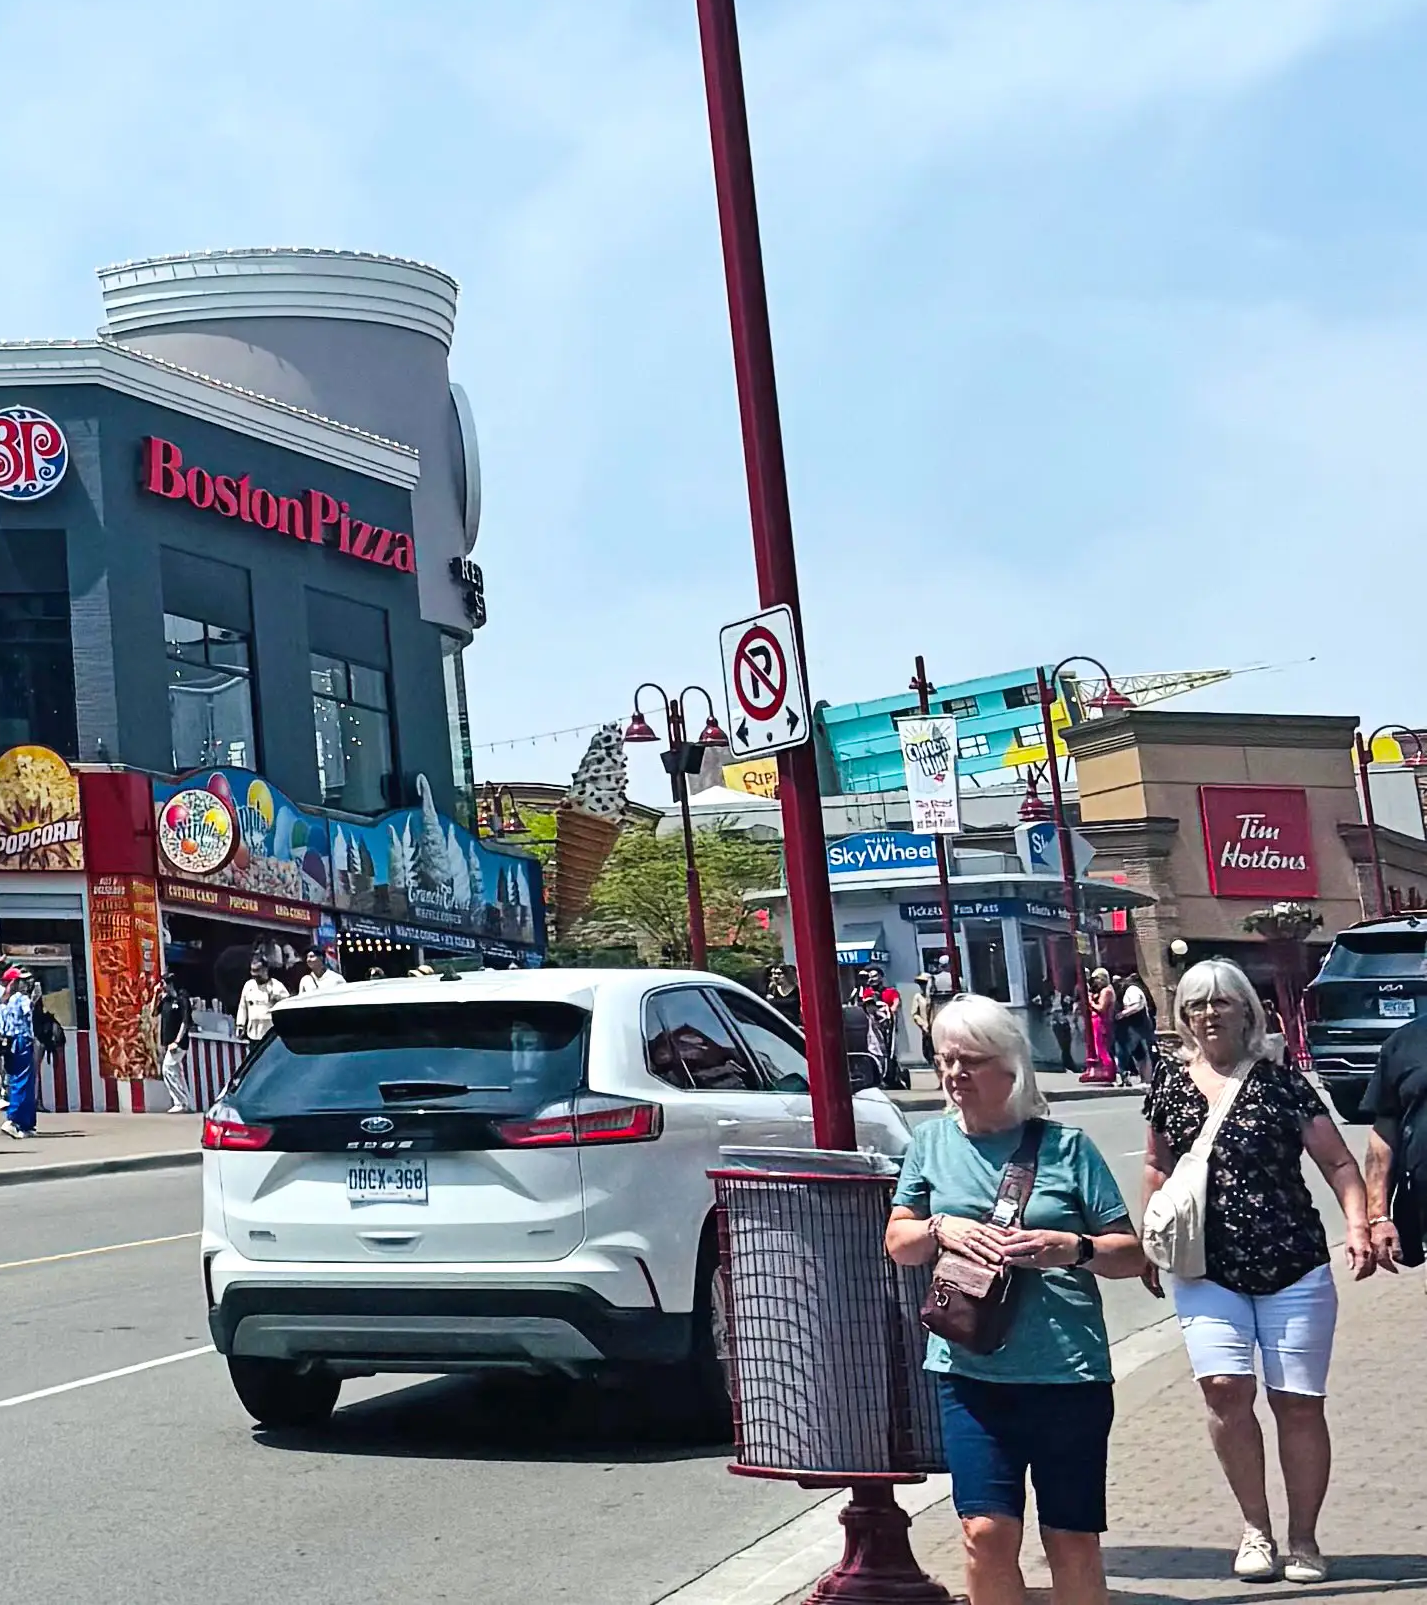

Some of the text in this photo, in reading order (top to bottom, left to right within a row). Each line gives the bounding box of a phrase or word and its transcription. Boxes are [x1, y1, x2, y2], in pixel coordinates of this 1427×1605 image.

[1236, 814, 1279, 839] Tim
[830, 841, 937, 867] SkyWheel
[1221, 841, 1306, 870] Hortons
[975, 903, 998, 915] Pass
